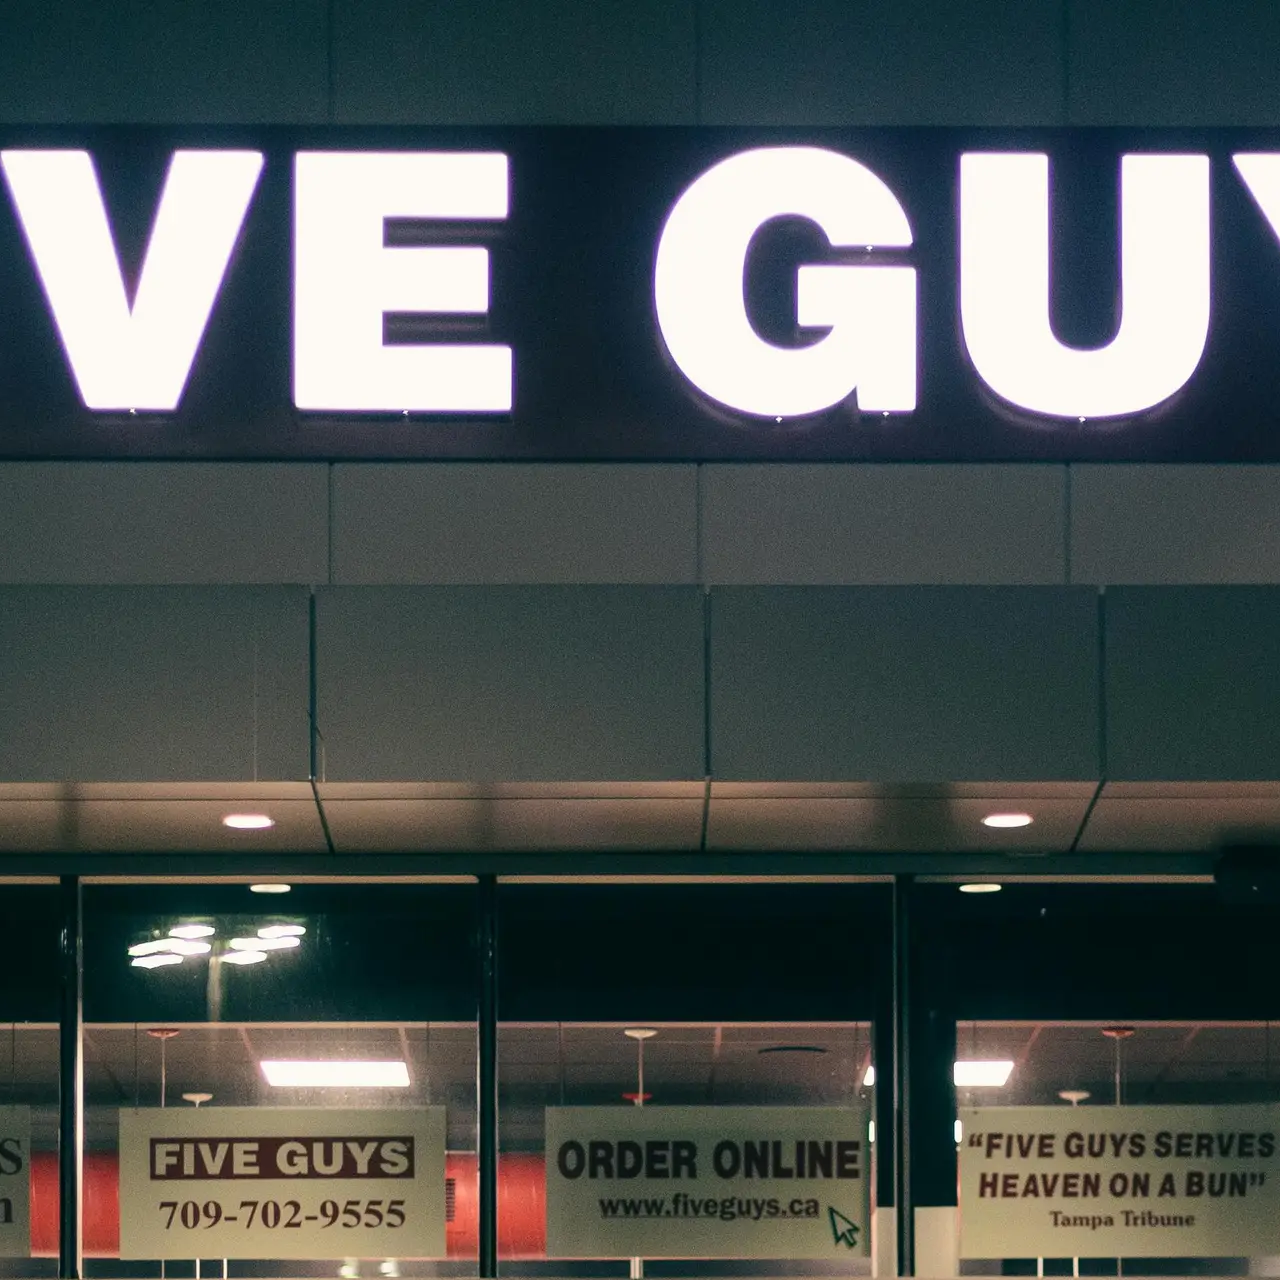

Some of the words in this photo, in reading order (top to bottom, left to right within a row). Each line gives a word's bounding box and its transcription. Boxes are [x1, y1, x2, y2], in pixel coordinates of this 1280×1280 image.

[153, 1142, 259, 1175] FIVE
[275, 1140, 411, 1177] GUYS
[556, 1138, 698, 1180] ORDER
[711, 1138, 860, 1181] ONLINE
[1063, 1131, 1145, 1159] GUYS
[1153, 1131, 1275, 1159] SERVES
[978, 1172, 1101, 1198] HEAVEN
[1108, 1173, 1150, 1198] ON
[1157, 1173, 1175, 1198] A
[158, 1198, 407, 1230] 709-702-9555
[599, 1191, 820, 1221] www.fiveguys.ca
[1049, 1210, 1115, 1231] Tampa
[1121, 1210, 1195, 1229] Tribune
